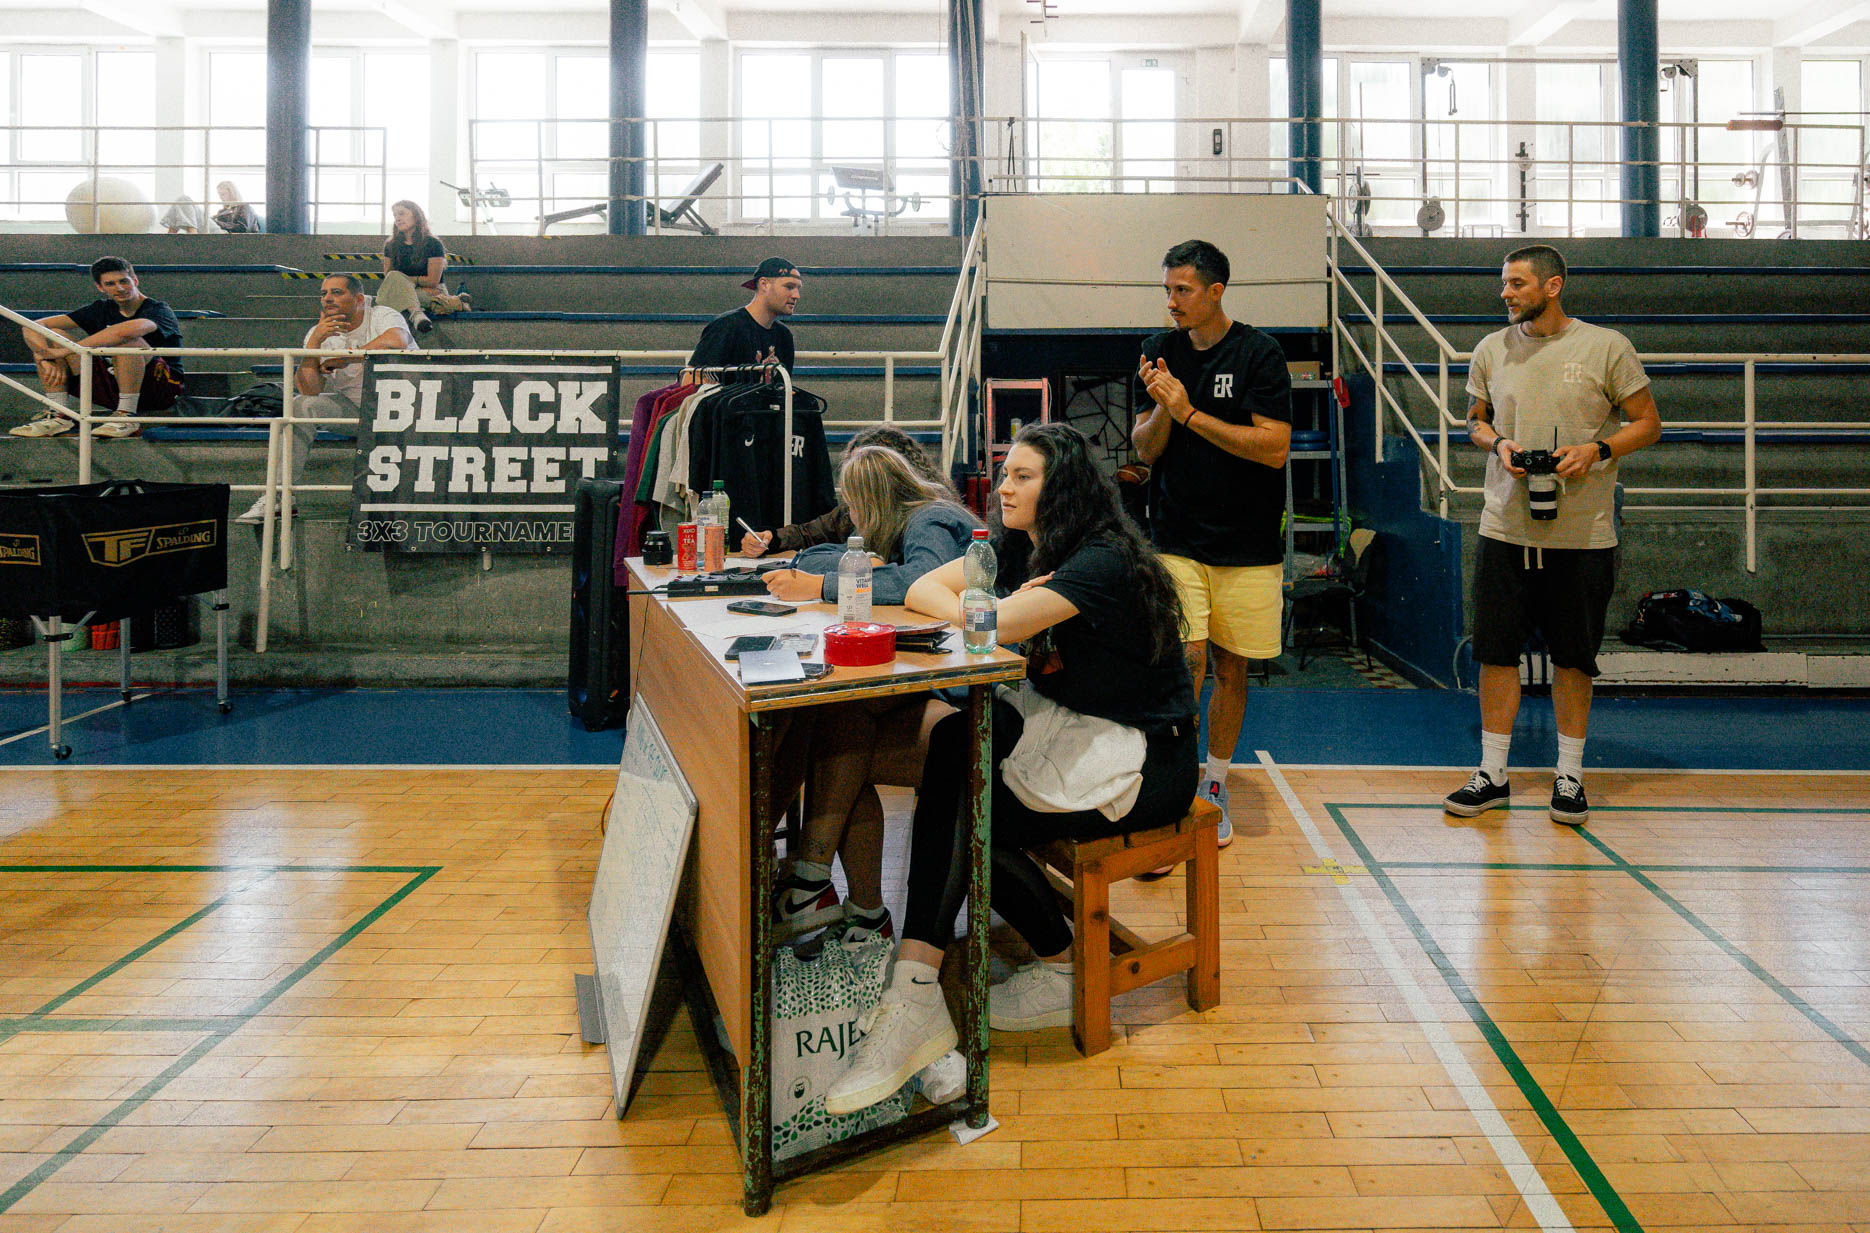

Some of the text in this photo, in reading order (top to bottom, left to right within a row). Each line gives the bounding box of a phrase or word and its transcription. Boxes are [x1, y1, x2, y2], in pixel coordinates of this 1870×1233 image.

[372, 379, 608, 434] BLACK
[366, 445, 609, 493] STREET
[156, 530, 211, 550] SPALDING
[357, 520, 575, 543] 3X3 TOURNAME
[795, 1018, 862, 1061] RAJE
